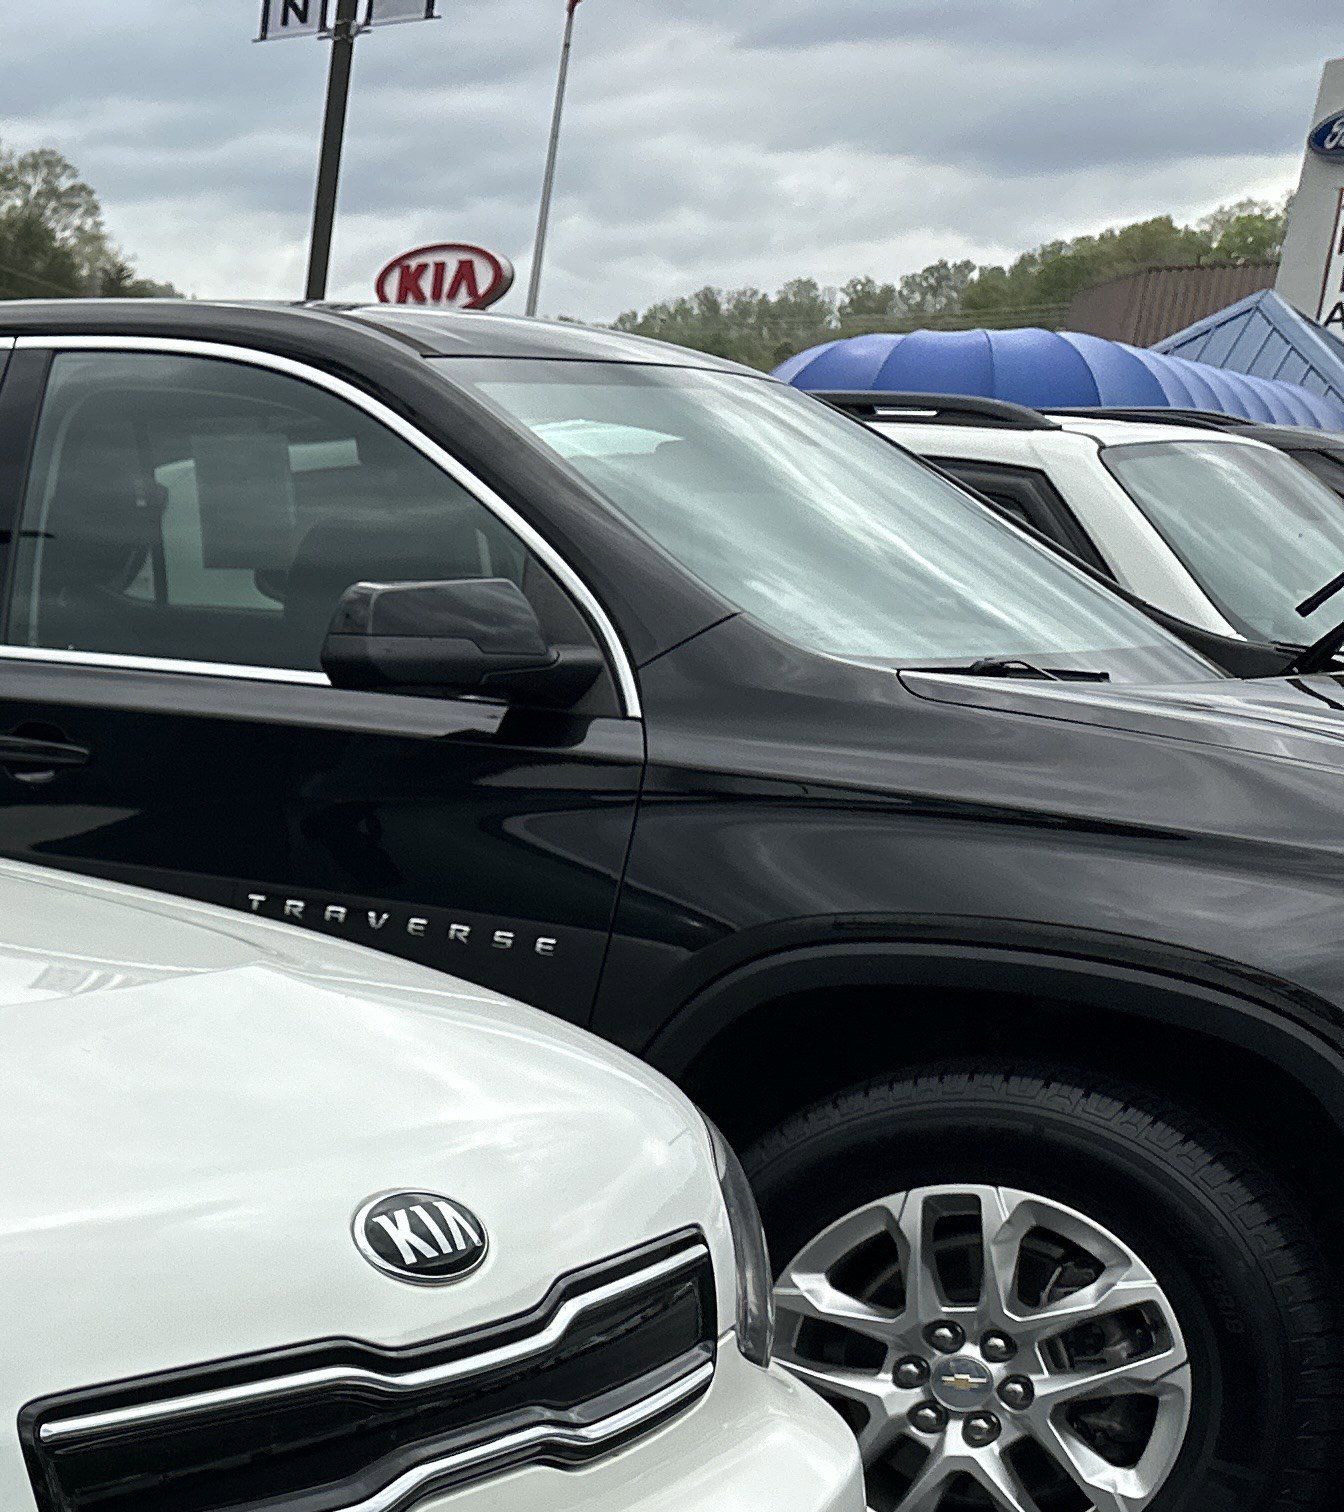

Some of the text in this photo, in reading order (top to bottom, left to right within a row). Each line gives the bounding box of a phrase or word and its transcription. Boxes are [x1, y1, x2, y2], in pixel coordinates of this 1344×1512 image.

[395, 259, 481, 305] KIA
[247, 893, 558, 957] TRAVERSE
[371, 1201, 483, 1265] KIA
